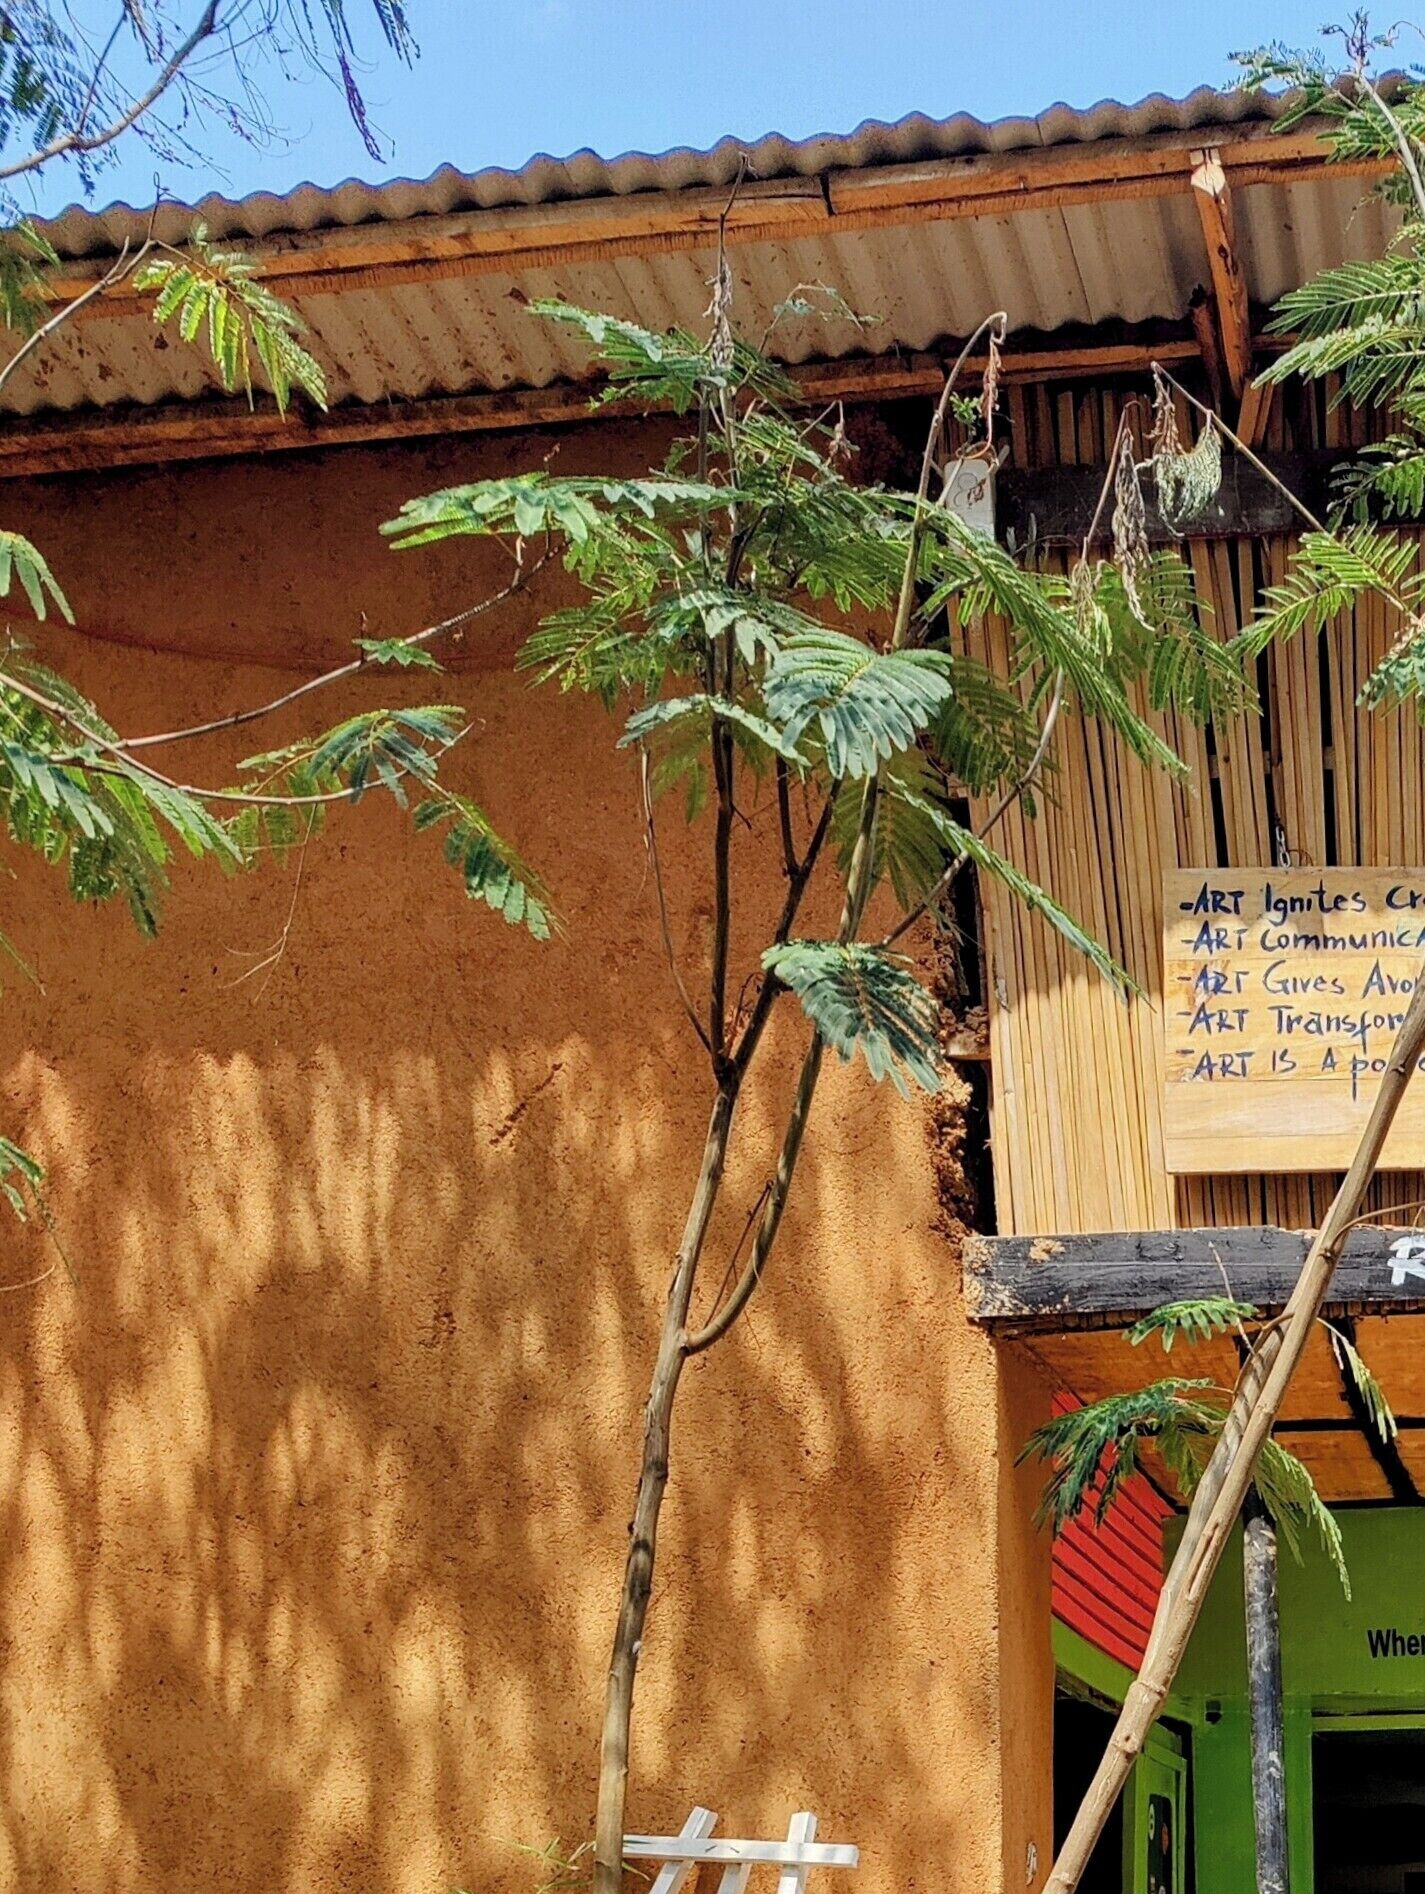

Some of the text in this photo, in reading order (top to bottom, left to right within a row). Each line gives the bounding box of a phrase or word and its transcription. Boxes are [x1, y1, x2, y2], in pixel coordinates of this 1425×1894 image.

[1264, 879, 1367, 927] Ignites
[1262, 960, 1346, 995] Gives
[1321, 1047, 1339, 1073] A
